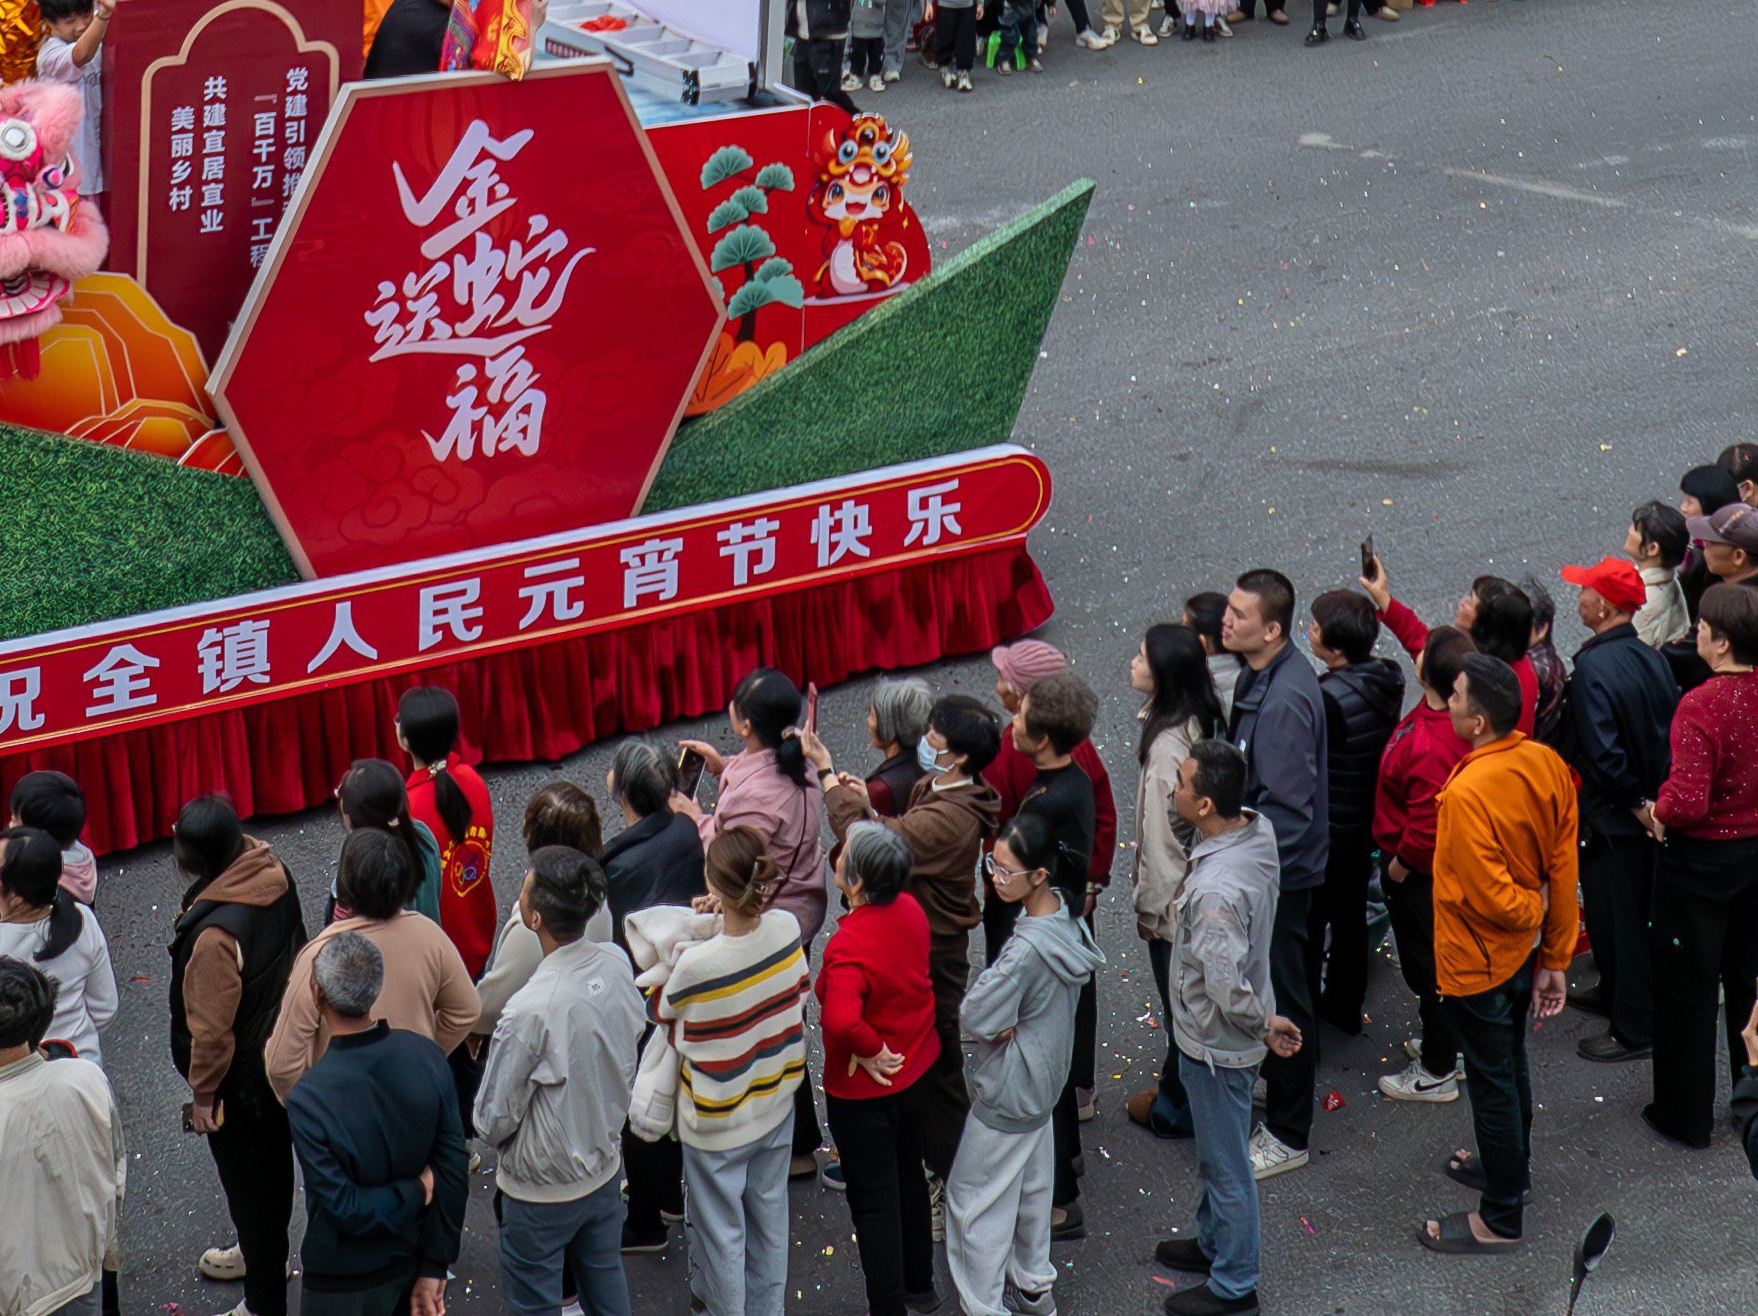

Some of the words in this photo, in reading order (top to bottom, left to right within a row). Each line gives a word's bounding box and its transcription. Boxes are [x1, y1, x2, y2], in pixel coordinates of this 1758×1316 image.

[169, 105, 196, 214] 美丽乡村
[199, 76, 228, 234] 共建宜居宜业
